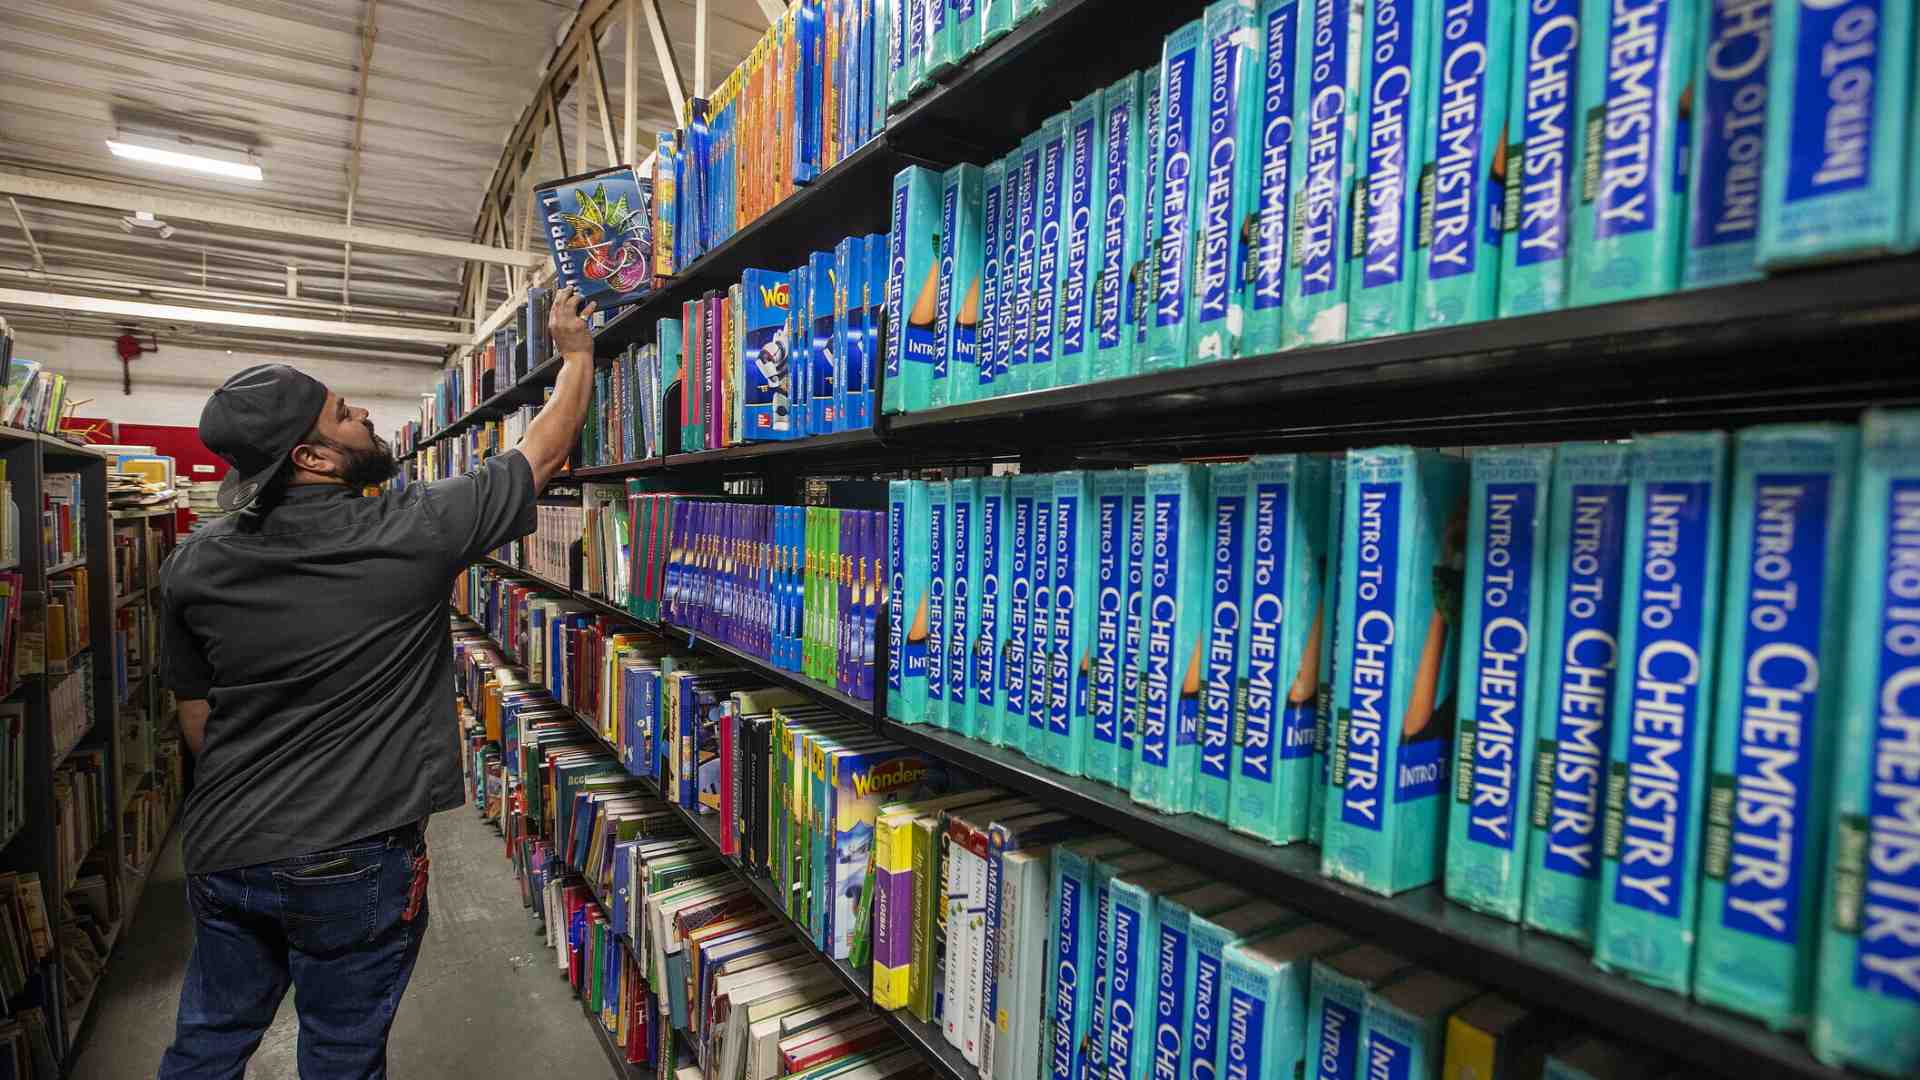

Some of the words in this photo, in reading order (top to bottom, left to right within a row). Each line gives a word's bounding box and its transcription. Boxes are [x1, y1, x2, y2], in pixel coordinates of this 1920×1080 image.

[1267, 14, 1287, 86] INTRO
[1375, 21, 1399, 63] TO
[1446, 1, 1473, 40] TO
[1821, 7, 1876, 76] TO
[1167, 60, 1185, 119] INTRO
[1212, 41, 1229, 102] INTRO
[1314, 43, 1335, 82] TO
[1211, 104, 1228, 134] TO
[1266, 87, 1284, 113] TO
[1812, 67, 1872, 186] INTRO
[1074, 127, 1087, 180] INTRO
[1110, 112, 1123, 164] INTRO
[1167, 119, 1181, 148] TO
[1433, 41, 1487, 265] CHEMISTRY
[1522, 15, 1578, 249] CHEMISTRY
[1044, 146, 1058, 197] INTRO
[1073, 181, 1086, 204] TO
[1108, 165, 1121, 190] TO
[1303, 86, 1345, 284] CHEMISTRY
[1366, 65, 1411, 275] CHEMISTRY
[1043, 199, 1053, 218] TO
[1158, 152, 1190, 317] CHEMISTRY
[1204, 136, 1235, 312] CHEMISTRY
[1258, 115, 1292, 298] CHEMISTRY
[547, 211, 579, 288] LGEBRA
[1065, 206, 1089, 349] CHEMISTRY
[1101, 193, 1125, 343] CHEMISTRY
[887, 256, 905, 377] CHEMISTRY
[935, 256, 954, 378] CHEMISTRY
[998, 244, 1019, 373] CHEMISTRY
[1014, 229, 1036, 363] CHEMISTRY
[1034, 220, 1059, 357] CHEMISTRY
[909, 339, 936, 356] INTR
[957, 339, 975, 354] INT
[981, 258, 998, 379] CHEMISTRY
[931, 511, 940, 551] INTRO
[957, 508, 965, 550] INTRO
[985, 503, 994, 547] INTRO
[1016, 504, 1027, 549] INTRO
[1037, 508, 1048, 556] INTRO
[1057, 504, 1069, 554] INTRO
[1101, 503, 1114, 553] INTRO
[1155, 502, 1171, 559] INTRO
[1217, 505, 1235, 565] INTRO
[1258, 492, 1276, 553] INTRO
[1360, 492, 1386, 565] INTRO
[1489, 494, 1517, 566] INTRO
[1571, 496, 1607, 576] INTRO
[1646, 494, 1687, 581] INTRO
[1754, 486, 1800, 582] INTRO
[892, 551, 899, 568] TO
[931, 551, 941, 572] TO
[956, 550, 965, 572] TO
[984, 547, 994, 569] TO
[1015, 549, 1025, 572] TO
[1036, 556, 1046, 581] TO
[1057, 554, 1067, 579] TO
[1101, 552, 1113, 581] TO
[1154, 558, 1170, 587] TO
[1216, 563, 1232, 593] TO
[1256, 553, 1274, 586] TO
[1359, 565, 1383, 601] TO
[1485, 568, 1513, 606] TO
[1570, 577, 1602, 619] TO
[1642, 580, 1681, 630] TO
[1751, 580, 1798, 632] TO
[889, 571, 904, 687] CHEMISTRY
[929, 577, 944, 695] CHEMISTRY
[952, 577, 968, 699] CHEMISTRY
[979, 573, 998, 701] CHEMISTRY
[1009, 577, 1029, 713] CHEMISTRY
[1030, 586, 1050, 727] CHEMISTRY
[1050, 585, 1074, 731] CHEMISTRY
[909, 656, 928, 669] INT
[1095, 587, 1121, 737] CHEMISTRY
[1144, 595, 1175, 761] CHEMISTRY
[1204, 601, 1239, 772] CHEMISTRY
[1246, 594, 1282, 775] CHEMISTRY
[1287, 728, 1316, 748] INTR
[1346, 609, 1395, 822] CHEMISTRY
[1472, 617, 1528, 838] CHEMISTRY
[1399, 764, 1436, 787] INTRO
[1550, 628, 1616, 868] CHEMISTRY
[1621, 640, 1700, 905] CHEMISTRY
[852, 760, 929, 800] Wonders
[1728, 643, 1820, 933] CHEMISTRY
[986, 859, 998, 937] AMERICAN
[1061, 882, 1074, 928] INTRO
[948, 921, 959, 1006] CHEMISTRY
[1060, 930, 1072, 955] TO
[1116, 911, 1131, 965] INTRO
[1160, 932, 1177, 988] INTRO
[968, 936, 979, 1023] CHEMISTRY
[983, 939, 994, 1020] GOVERNME
[1114, 966, 1129, 992] TO
[1159, 988, 1175, 1017] TO
[1196, 960, 1216, 1020] INTRO
[1055, 960, 1077, 1078] CHEMISTR
[1194, 1020, 1211, 1050] TO
[1229, 996, 1251, 1061] INTRO
[1321, 1008, 1346, 1073] INTRO
[1368, 1040, 1395, 1080] INT
